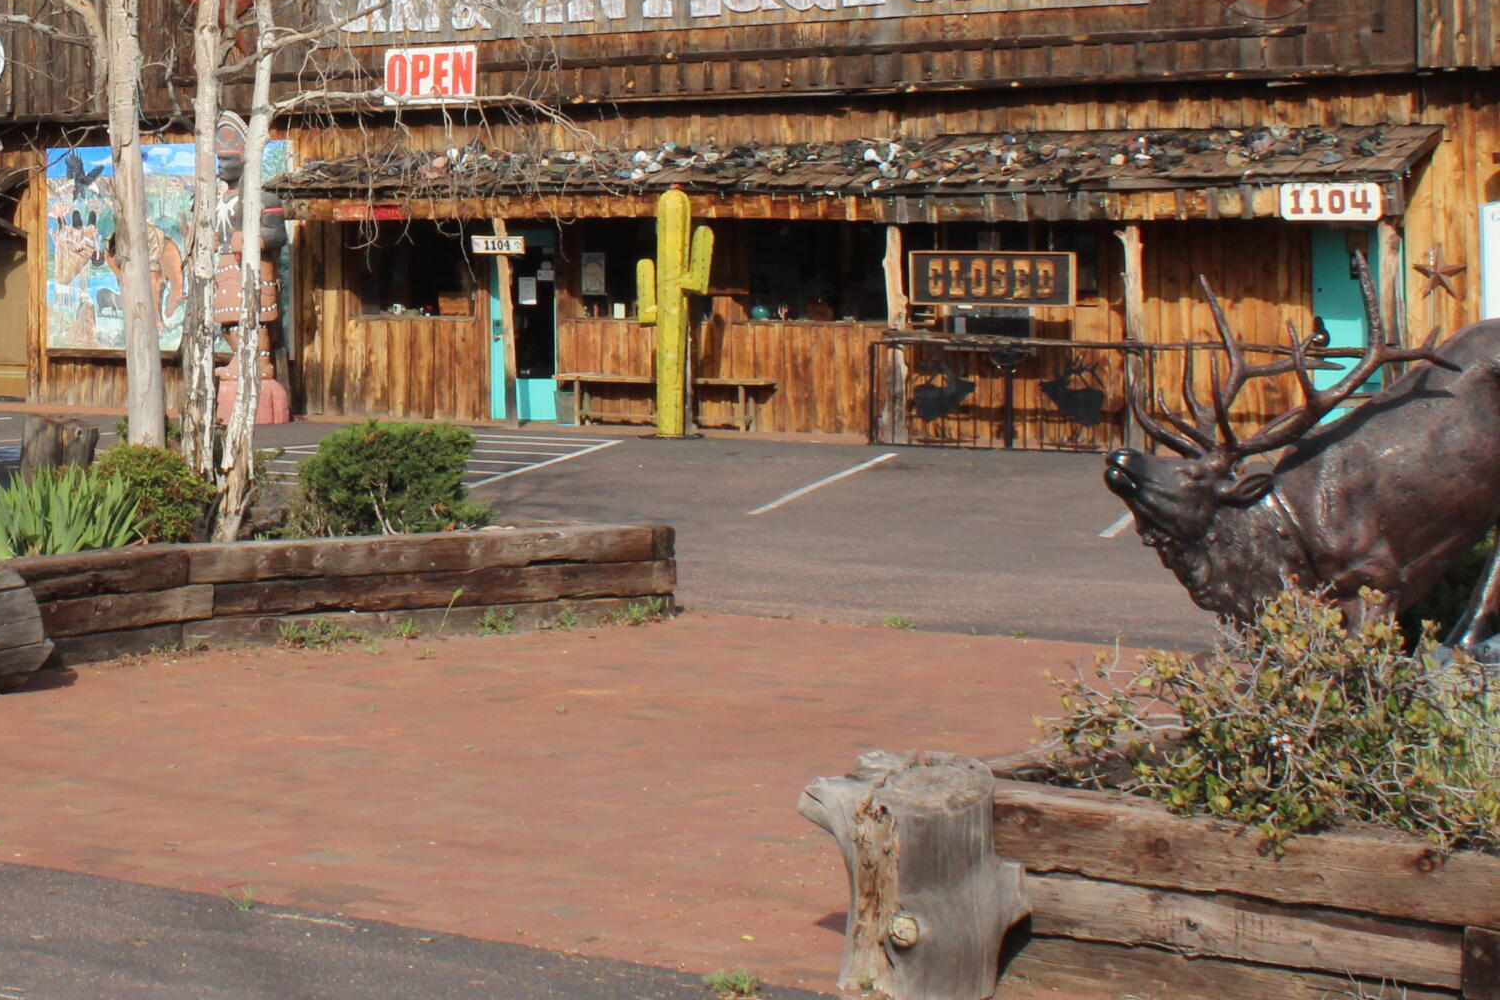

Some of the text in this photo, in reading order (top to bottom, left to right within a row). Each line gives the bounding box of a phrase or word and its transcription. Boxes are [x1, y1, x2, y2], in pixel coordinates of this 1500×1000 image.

[386, 51, 474, 96] OPEN
[1290, 188, 1372, 214] 1104
[484, 239, 511, 251] 1104
[928, 258, 1054, 299] CLOSED
